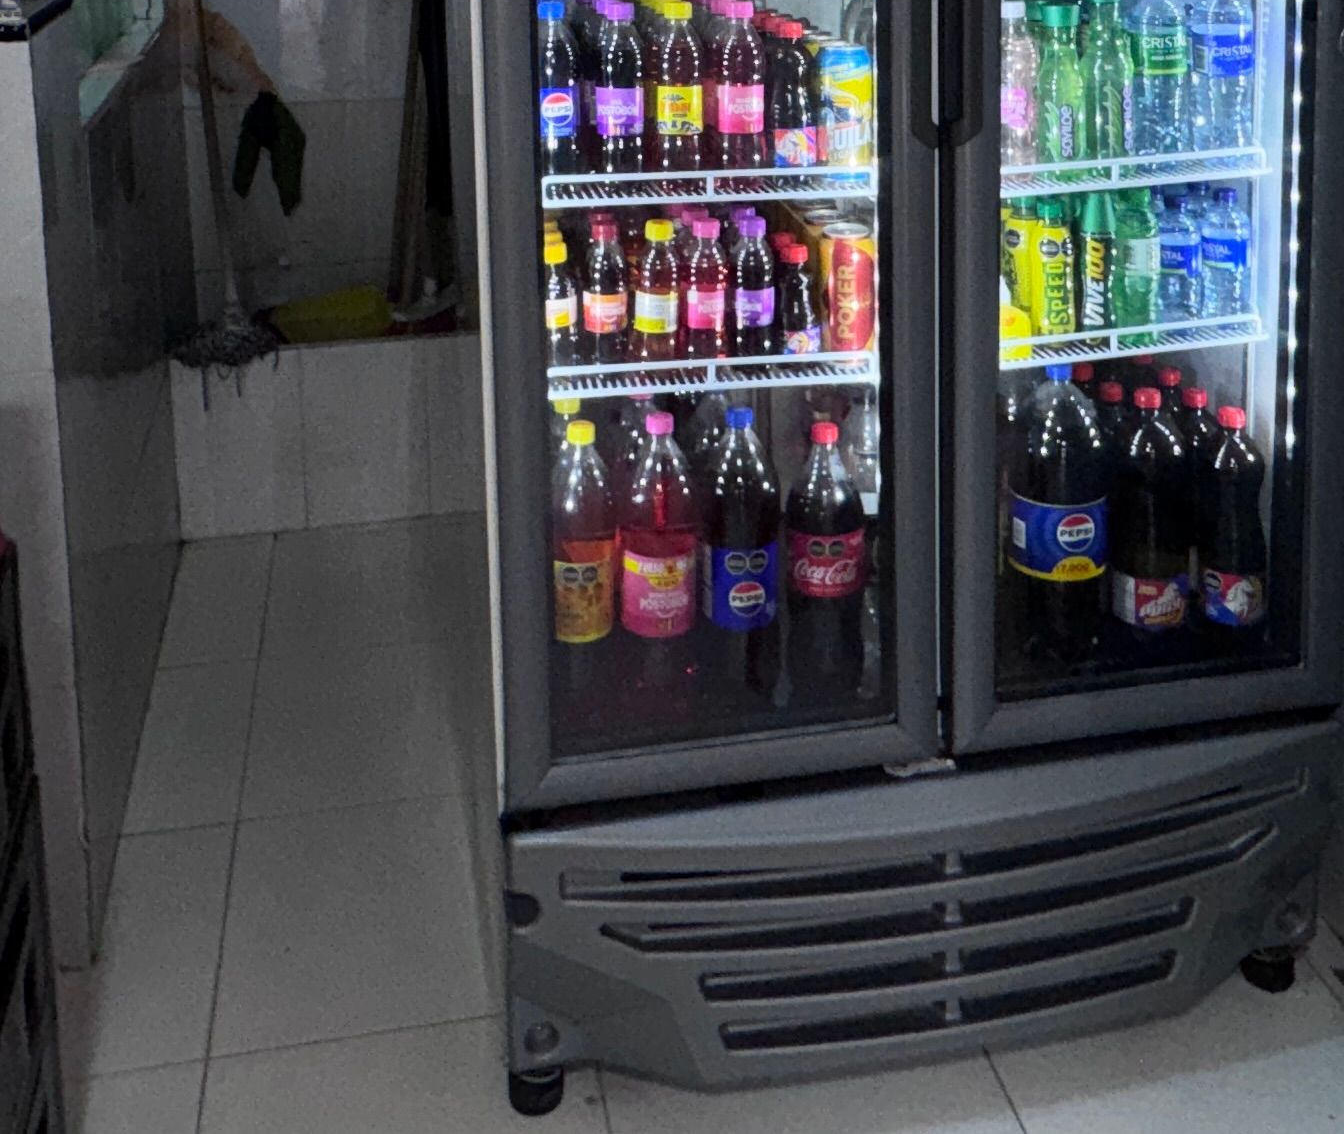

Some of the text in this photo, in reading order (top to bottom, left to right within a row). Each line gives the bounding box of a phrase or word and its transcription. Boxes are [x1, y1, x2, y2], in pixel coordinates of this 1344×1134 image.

[837, 265, 855, 340] POKER
[1044, 263, 1068, 324] SPEED
[1059, 527, 1093, 538] PEPSI
